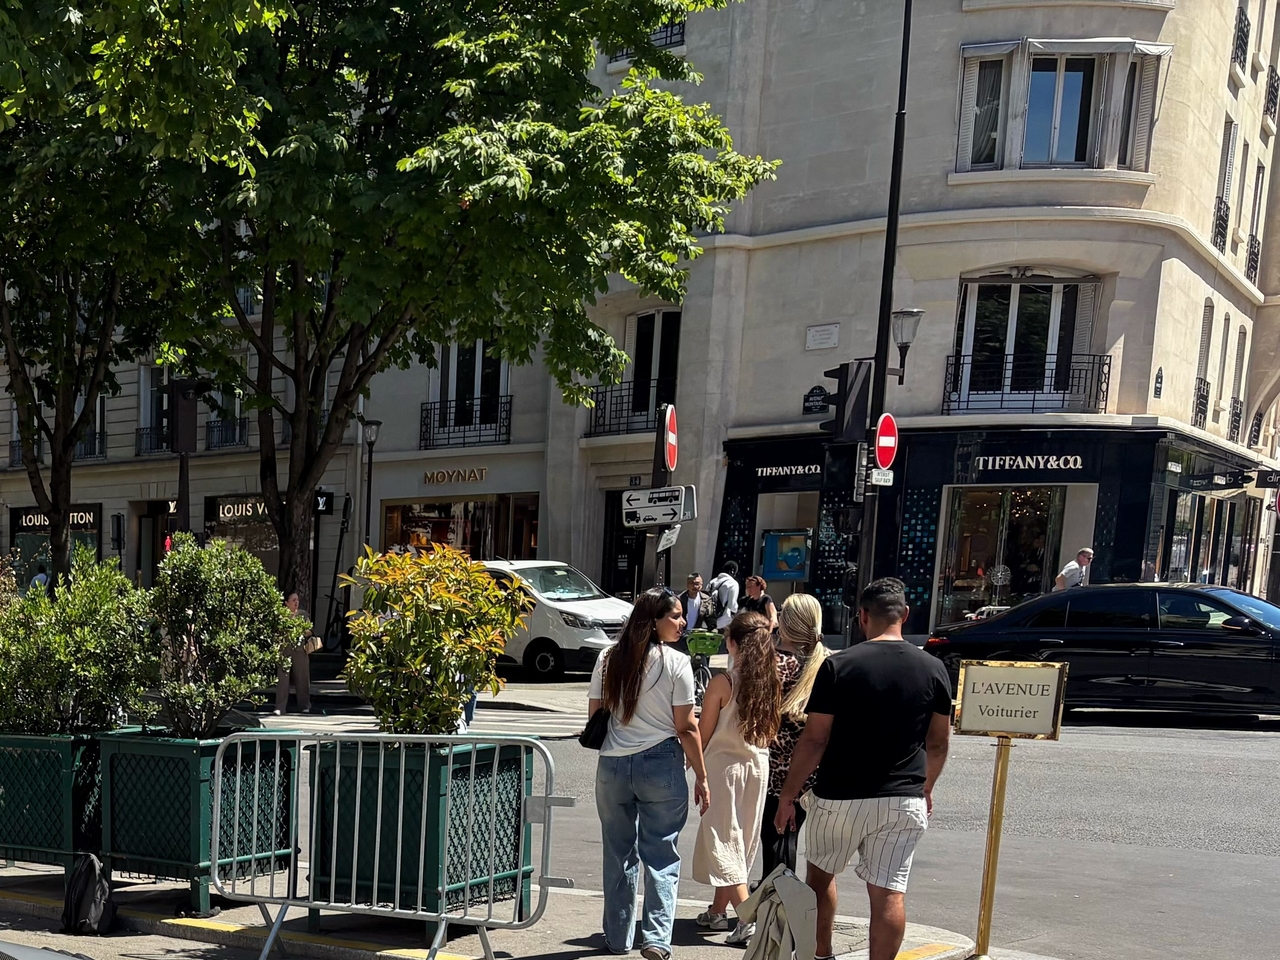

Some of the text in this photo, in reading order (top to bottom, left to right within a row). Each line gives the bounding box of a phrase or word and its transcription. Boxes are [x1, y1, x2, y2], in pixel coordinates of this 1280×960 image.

[424, 467, 488, 485] MOYNAT
[219, 503, 253, 517] LOUIS
[22, 511, 94, 526] LOUIS TTON
[971, 682, 1051, 697] L'AVENUE
[978, 704, 1039, 719] Voiturier
